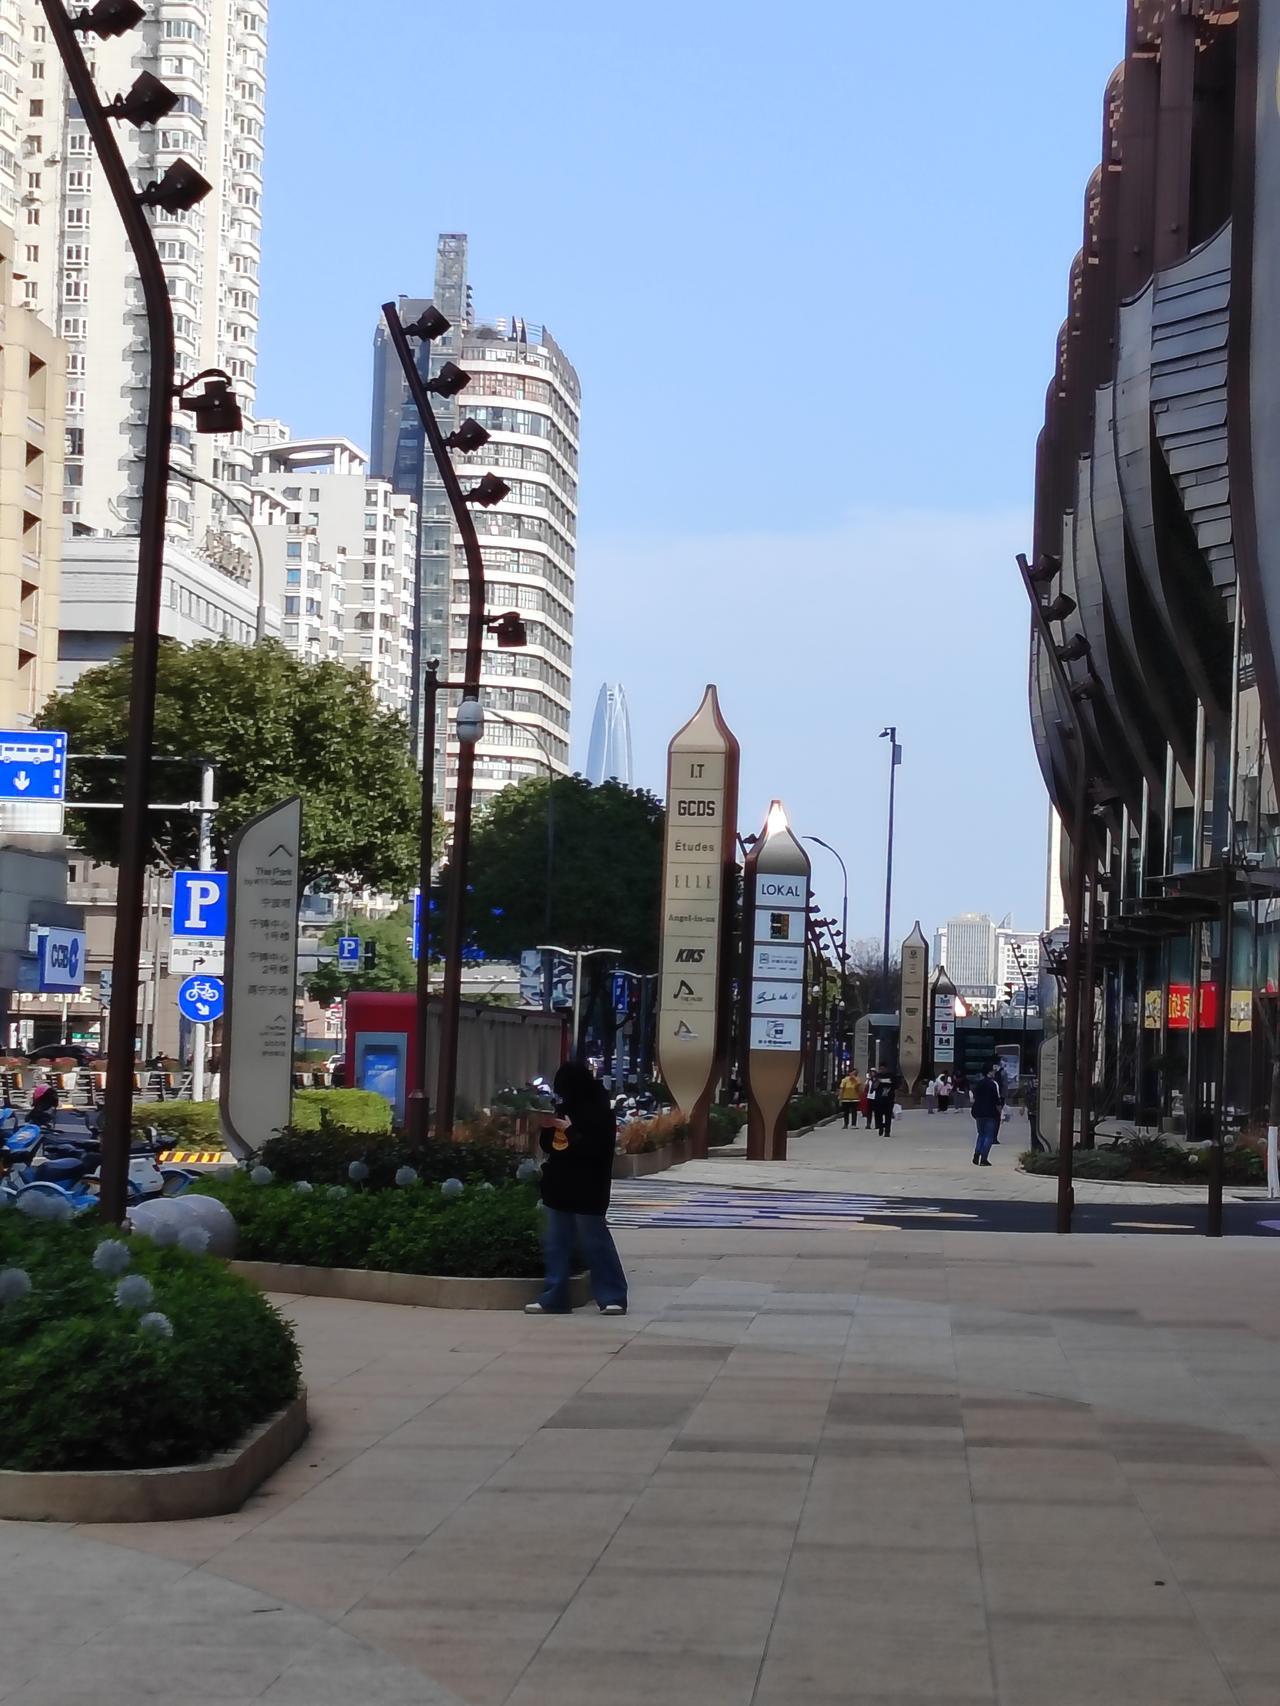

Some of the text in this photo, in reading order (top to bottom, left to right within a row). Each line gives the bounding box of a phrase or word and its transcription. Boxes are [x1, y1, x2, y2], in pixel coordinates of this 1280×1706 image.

[678, 800, 715, 817] GCDS
[675, 840, 715, 852] Études
[675, 874, 712, 889] ELLE
[761, 883, 800, 897] LOKAL
[184, 880, 220, 928] P
[342, 940, 356, 957] P
